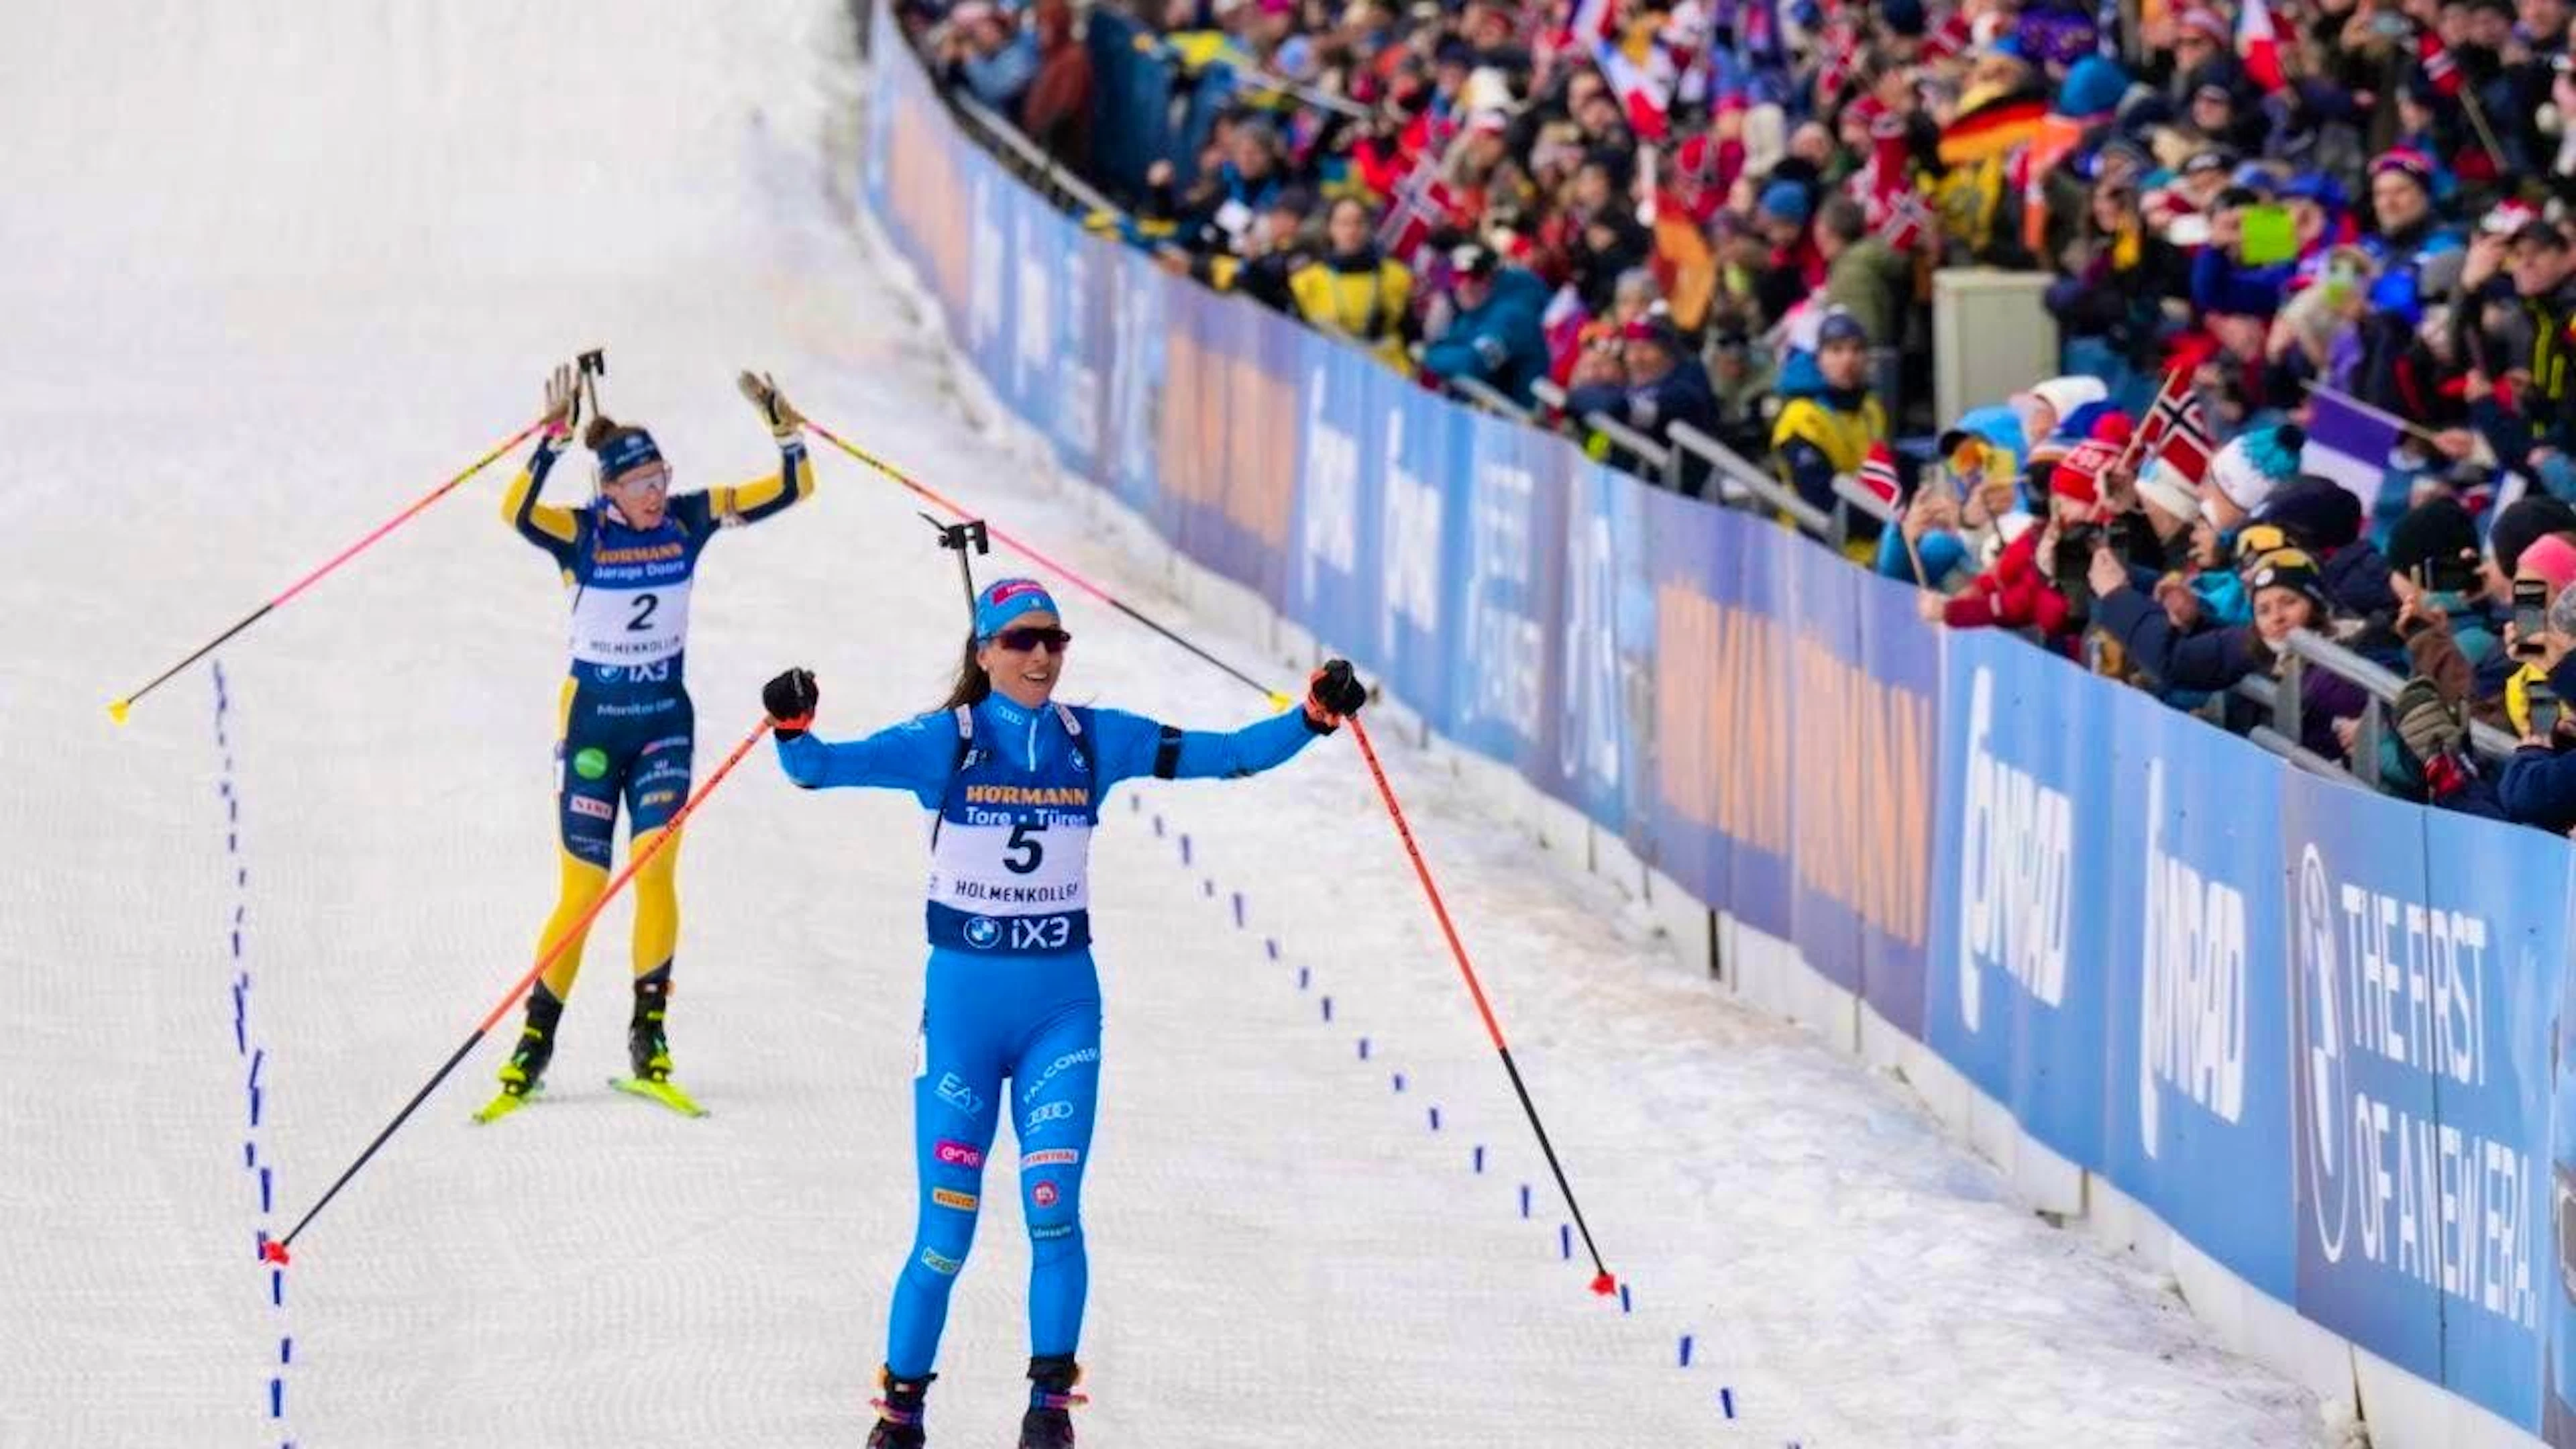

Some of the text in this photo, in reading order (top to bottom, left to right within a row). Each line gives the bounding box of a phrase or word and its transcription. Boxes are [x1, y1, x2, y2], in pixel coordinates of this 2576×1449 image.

[645, 560, 686, 576] Doors
[627, 593, 659, 631] 2
[965, 784, 1089, 806] HÖRMANN
[965, 806, 1012, 824] Tore
[1003, 825, 1048, 874] 5
[955, 880, 1078, 902] HOLMENKOLLE
[1011, 917, 1070, 949] iX3
[2342, 883, 2486, 1086] THE FIRST
[2355, 1093, 2392, 1263] OF
[2398, 1112, 2419, 1278] A
[2419, 1120, 2481, 1303] NEW
